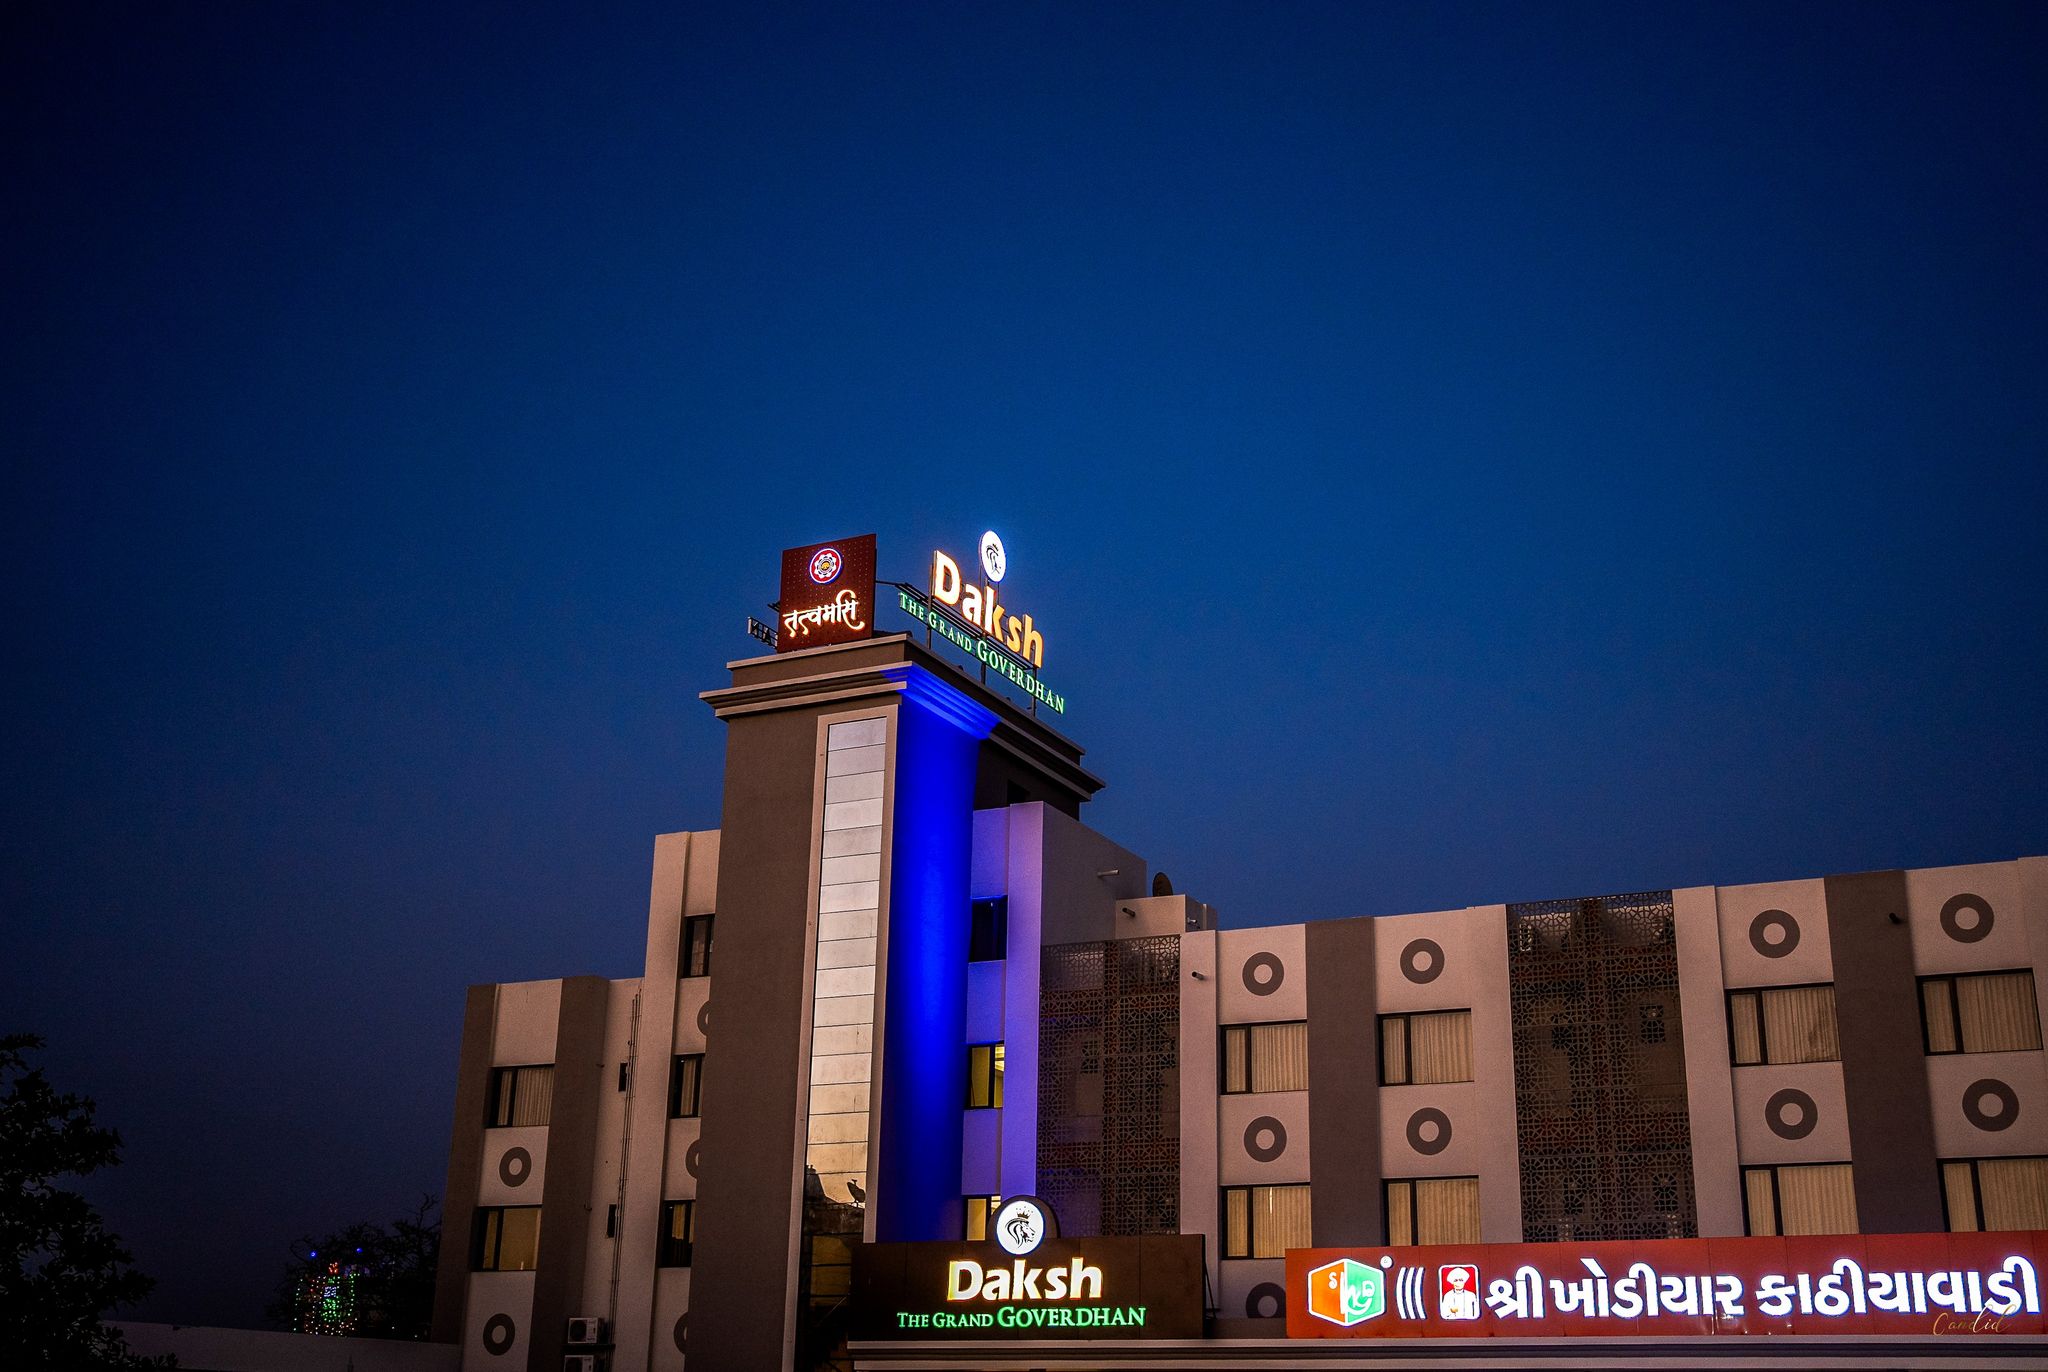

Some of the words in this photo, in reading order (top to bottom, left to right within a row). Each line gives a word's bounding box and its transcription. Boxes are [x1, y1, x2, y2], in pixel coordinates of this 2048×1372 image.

[932, 550, 1044, 668] Daksh
[898, 592, 925, 621] THE
[928, 611, 973, 653] GRAND
[977, 640, 1065, 714] GOVERDHAN
[947, 1257, 1103, 1301] Daksh
[1484, 1265, 1544, 1319] શ્રી
[1549, 1257, 1745, 1319] ખોડીયાર
[1755, 1255, 2040, 1316] કાઠીયાવાડી
[896, 1312, 929, 1328] THE
[932, 1312, 994, 1329] GRAND
[997, 1306, 1147, 1328] GOVERDHAN
